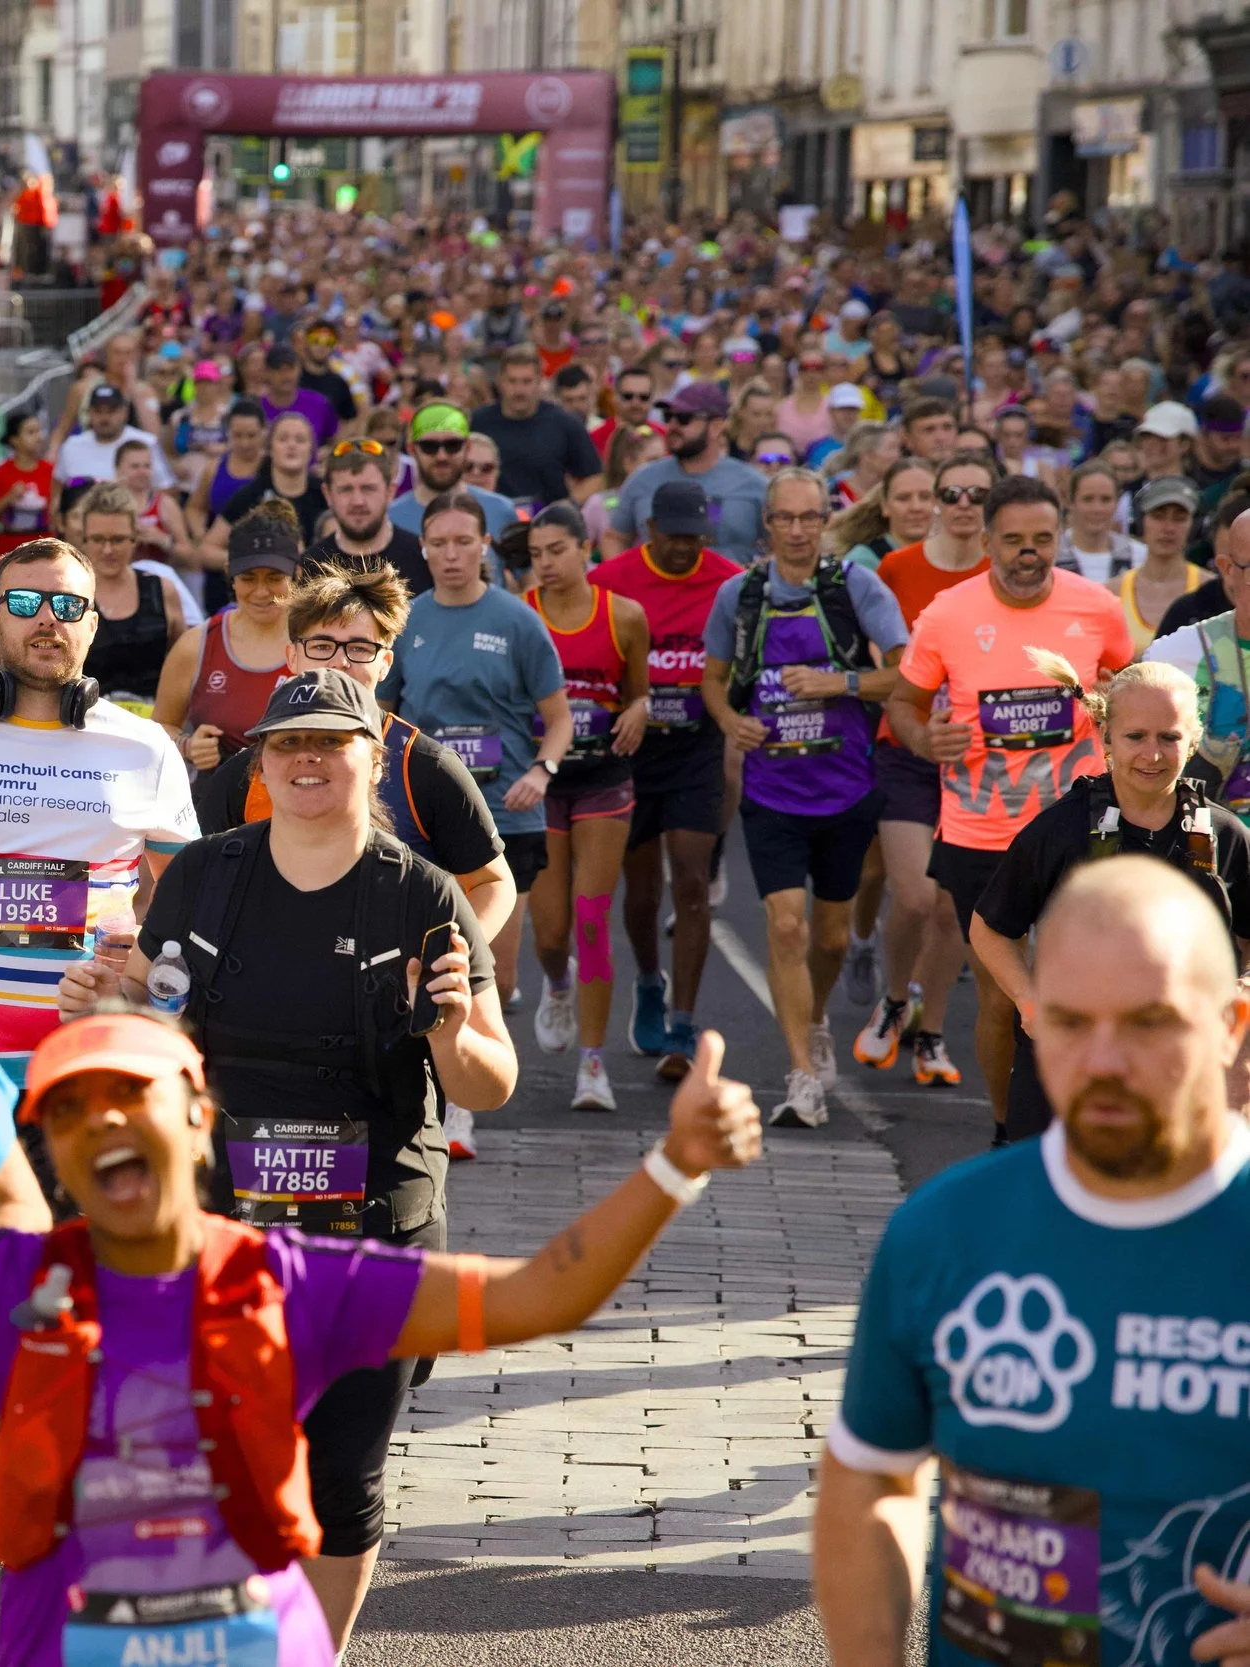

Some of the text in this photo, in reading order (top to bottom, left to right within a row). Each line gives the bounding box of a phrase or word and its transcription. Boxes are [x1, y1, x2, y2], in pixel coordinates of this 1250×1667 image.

[474, 632, 507, 646] ROYAL
[993, 701, 1062, 720] ANTONIO
[777, 712, 825, 729] ANGUS
[1010, 717, 1049, 733] 5087
[60, 766, 120, 783] canser
[41, 796, 112, 814] research
[7, 861, 66, 871] CARDIFF HALF
[0, 883, 54, 902] LUKE
[274, 1124, 340, 1135] CARDIFF HALF
[254, 1148, 337, 1169] HATTIE
[259, 1171, 330, 1192] 17856
[329, 1221, 357, 1231] 17856
[1111, 1359, 1250, 1419] HOT
